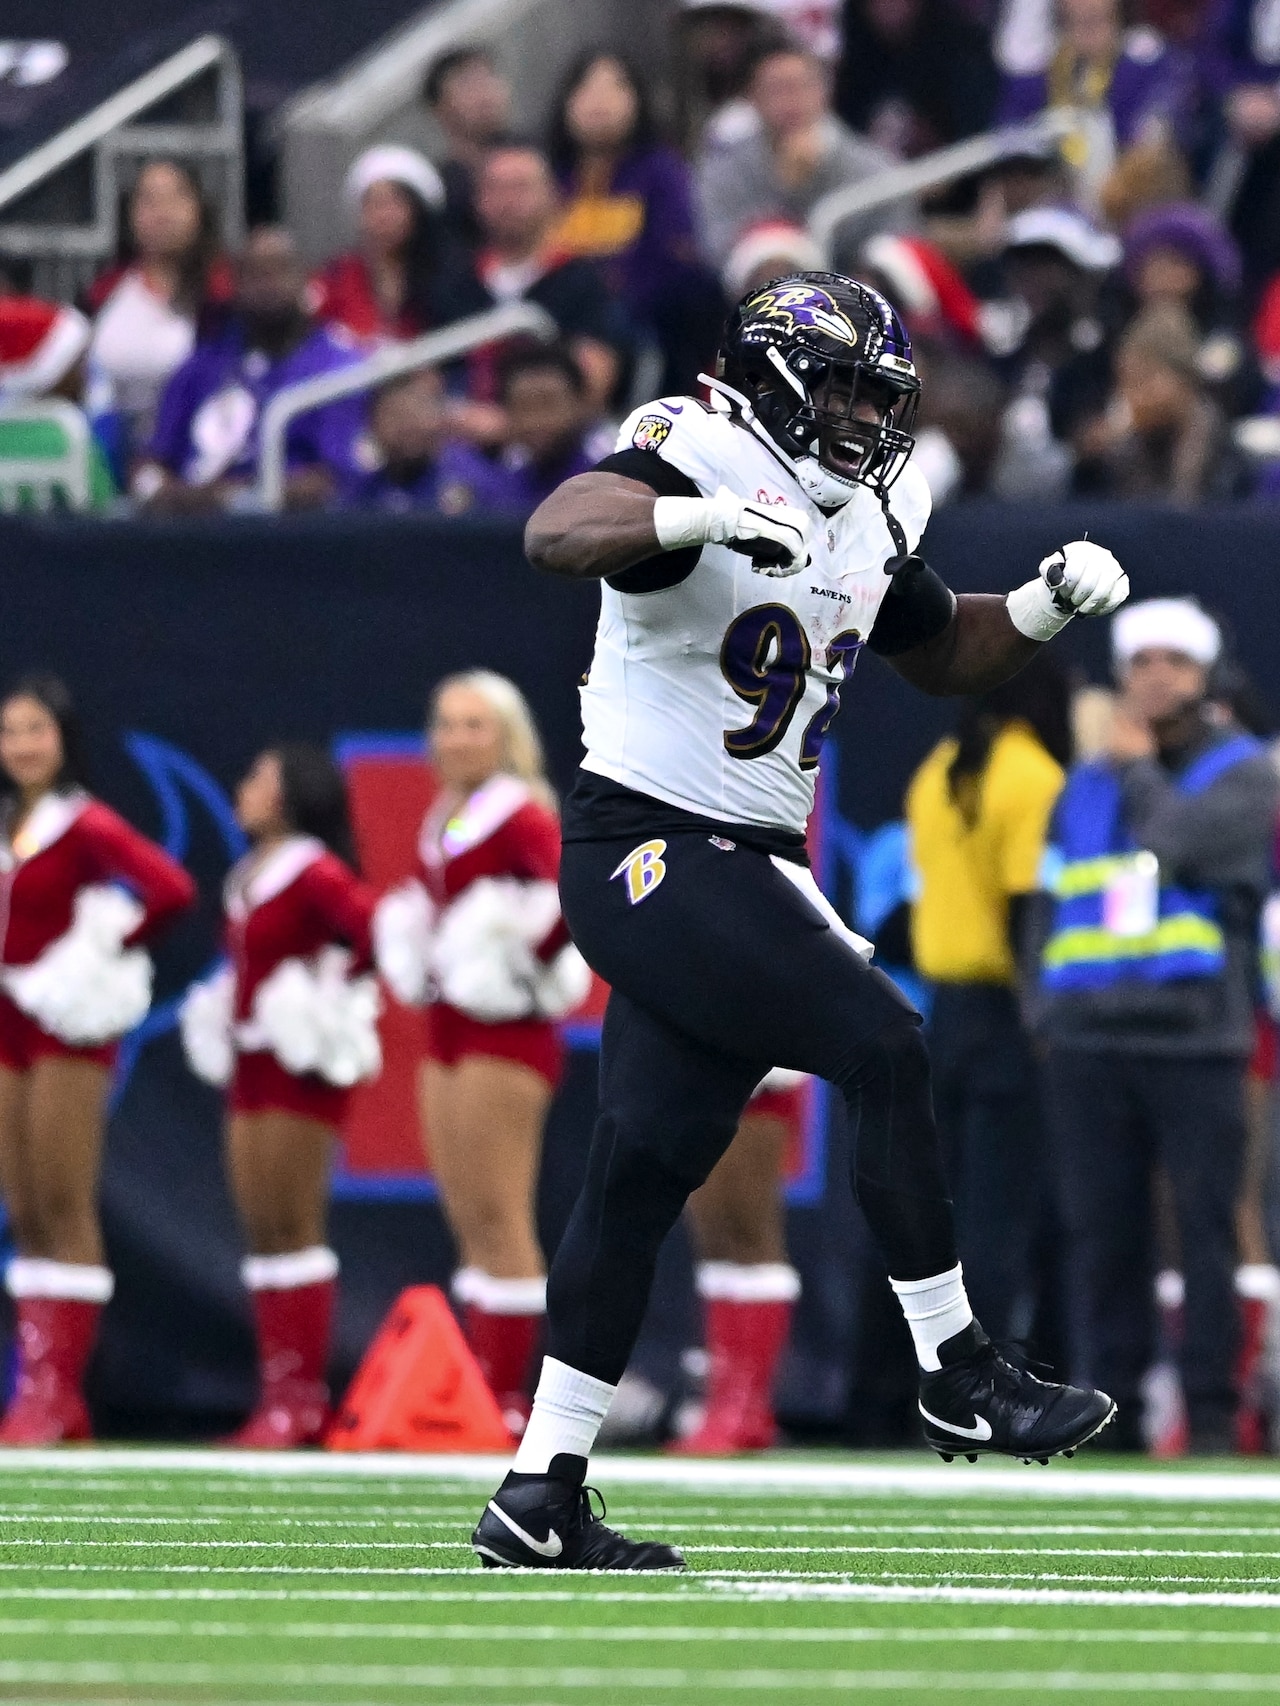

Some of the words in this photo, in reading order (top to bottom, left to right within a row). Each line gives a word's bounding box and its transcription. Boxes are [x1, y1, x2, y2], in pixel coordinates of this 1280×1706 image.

[810, 586, 852, 604] RAVENS
[720, 602, 866, 771] 92
[608, 839, 667, 905] B
